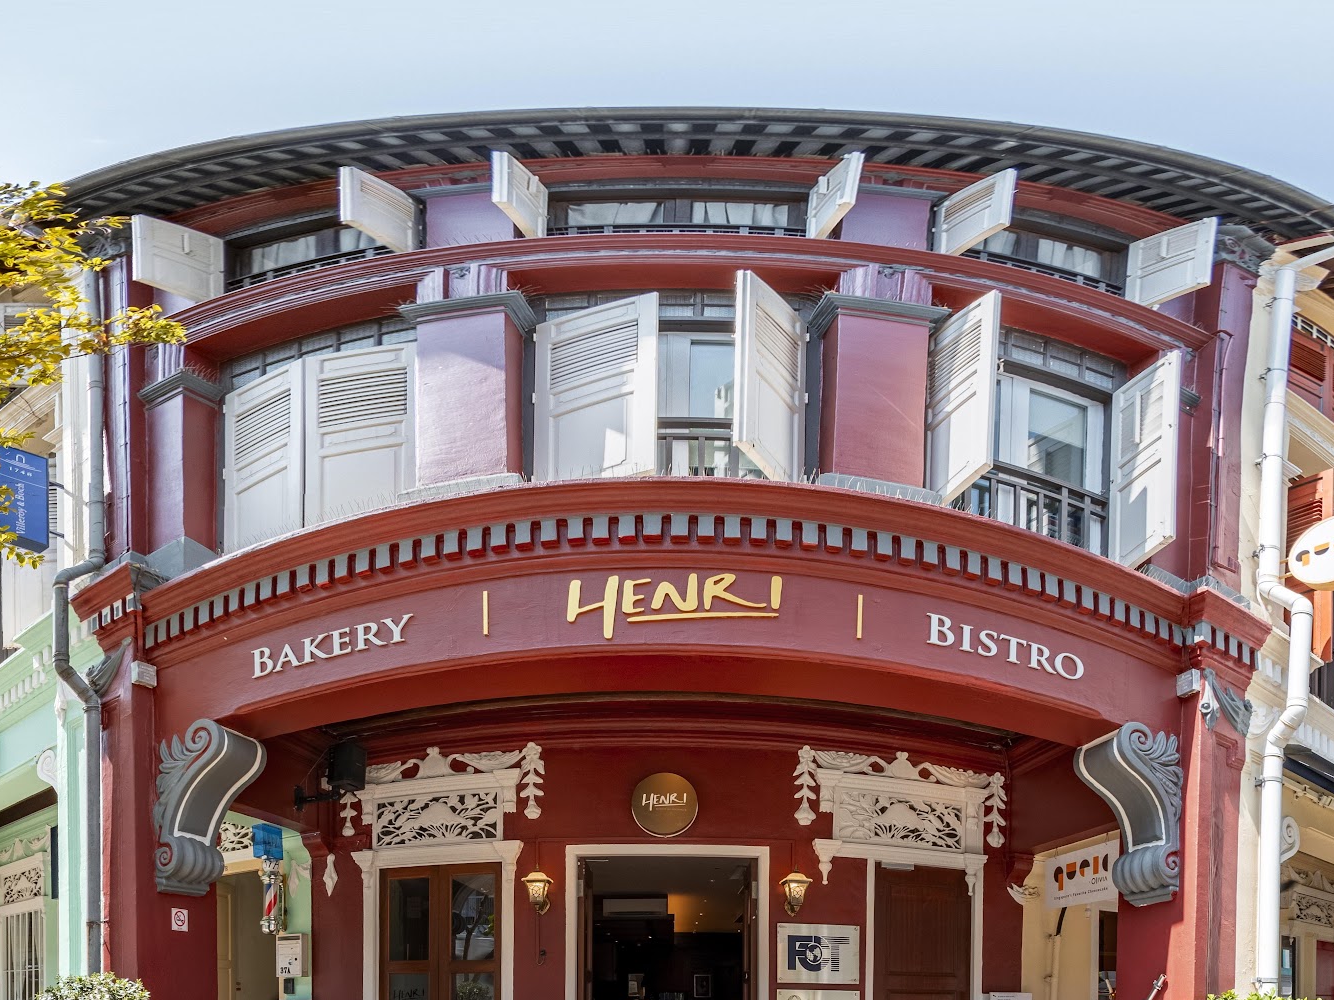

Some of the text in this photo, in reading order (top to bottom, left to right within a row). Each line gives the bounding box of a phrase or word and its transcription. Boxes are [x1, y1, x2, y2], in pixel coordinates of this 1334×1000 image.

[14, 483, 25, 500] Boch
[15, 508, 28, 534] Villeroy
[566, 573, 783, 640] HENRI
[251, 613, 414, 679] BAKERY
[926, 612, 1085, 681] BISTRO
[642, 792, 687, 812] HENRI
[280, 966, 291, 975] 37A
